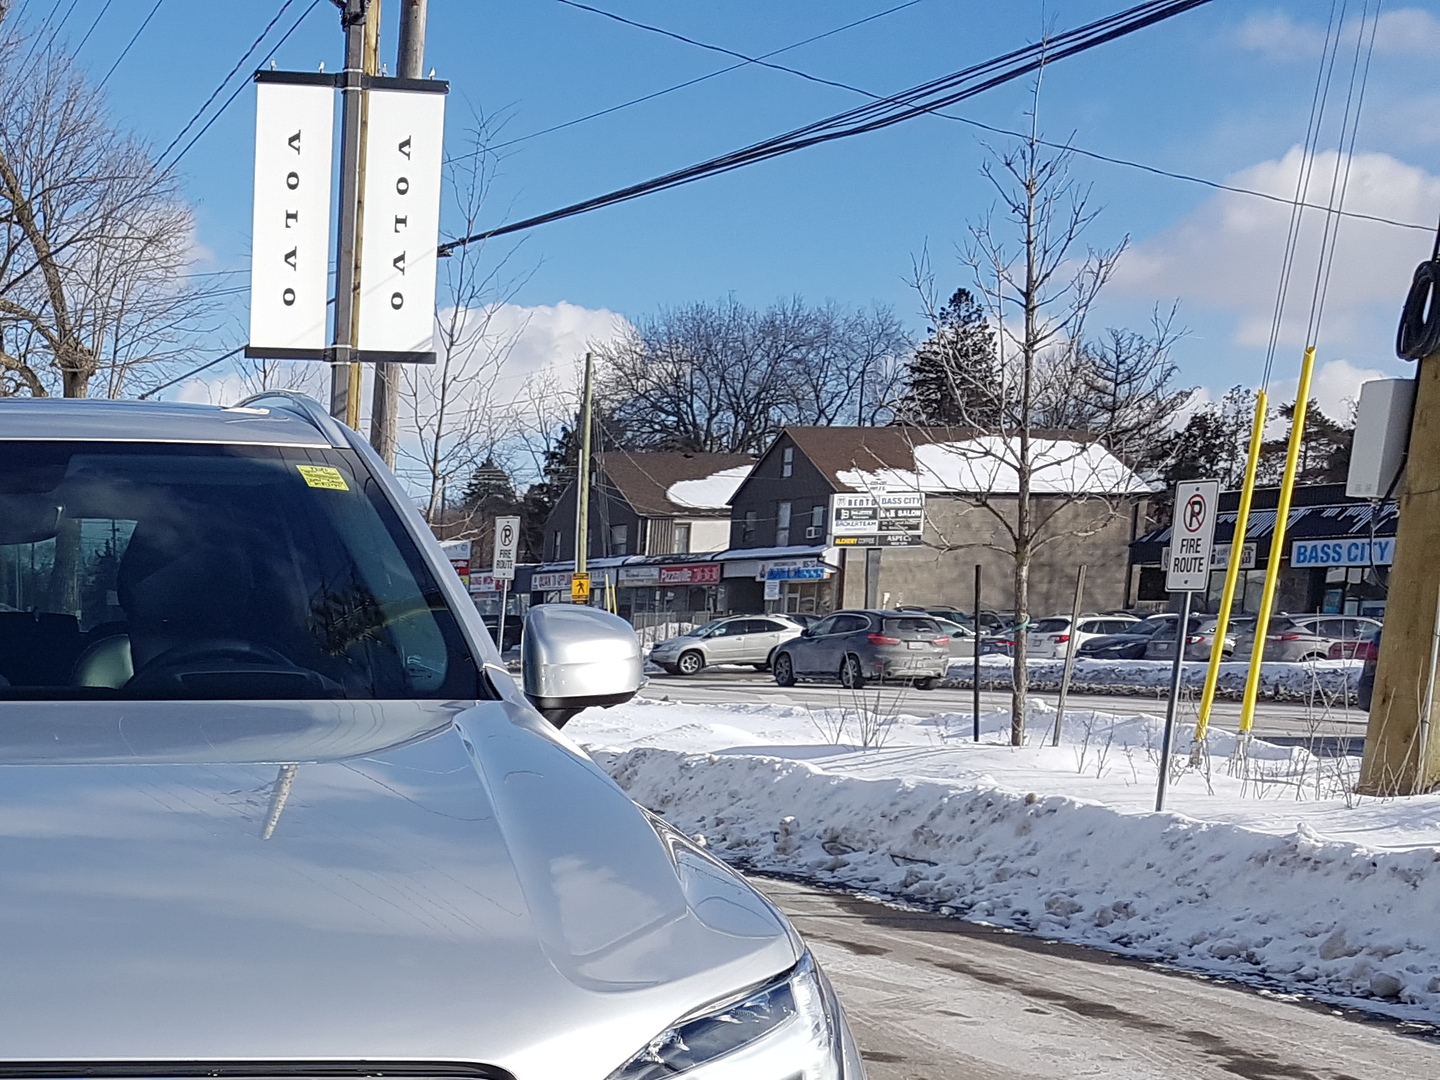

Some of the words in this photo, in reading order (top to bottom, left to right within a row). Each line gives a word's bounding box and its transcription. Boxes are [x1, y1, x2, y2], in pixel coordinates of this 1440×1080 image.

[282, 129, 302, 307] VOLVO
[390, 134, 412, 310] VOLVO
[881, 497, 902, 505] BASS
[903, 497, 921, 505] CITY
[499, 549, 512, 559] FIRE
[1179, 538, 1202, 555] FIRE
[1295, 543, 1343, 564] BASS
[1347, 540, 1390, 562] CITY
[496, 560, 513, 570] ROUTE
[1172, 556, 1205, 573] ROUTE
